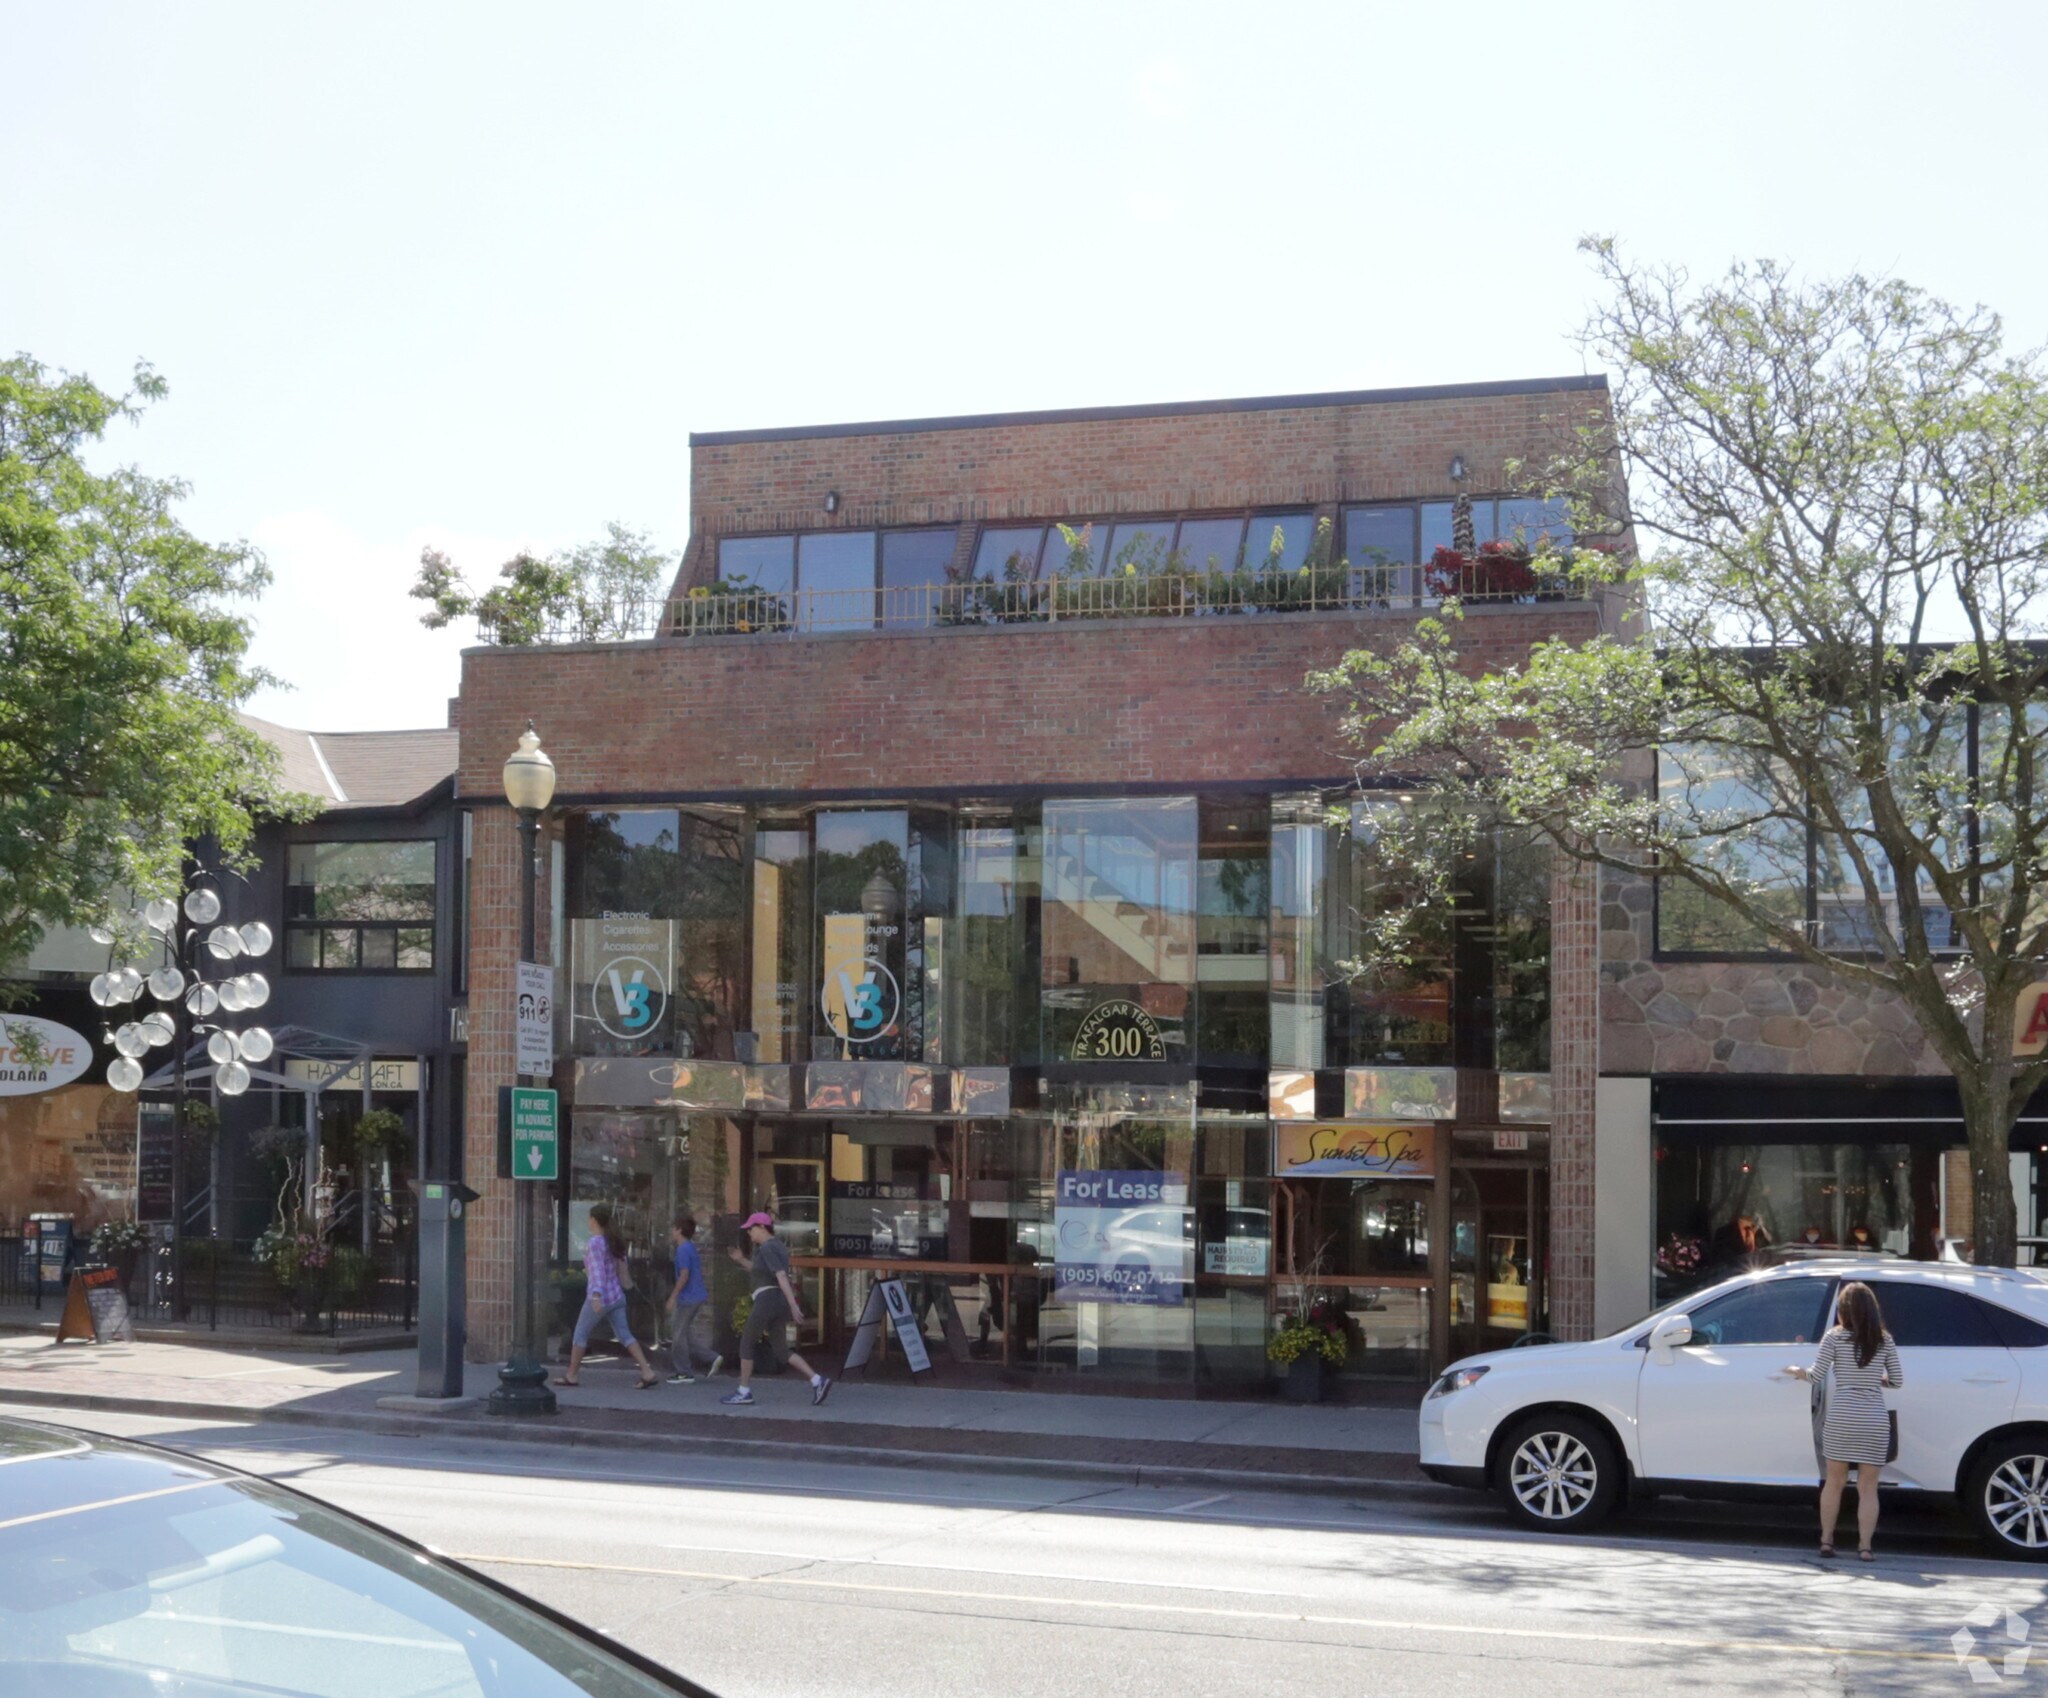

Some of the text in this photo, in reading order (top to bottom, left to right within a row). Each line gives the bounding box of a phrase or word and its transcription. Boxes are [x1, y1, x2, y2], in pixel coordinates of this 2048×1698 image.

[602, 910, 650, 920] Electronic
[602, 925, 650, 936] Cigarettes
[861, 925, 899, 938] ounge
[603, 941, 659, 952] Accessories
[519, 1006, 536, 1020] 911
[1077, 1004, 1162, 1058] TRAFALGAR TERRACE
[1095, 1027, 1141, 1057] 300
[307, 1063, 404, 1081] HACAFT
[358, 1081, 403, 1089] SON.CA
[520, 1098, 550, 1111] PAY HERE
[517, 1113, 553, 1126] IN ADVANCE
[515, 1129, 555, 1142] FOR PARKING
[1498, 1132, 1521, 1147] EXIT
[1288, 1128, 1425, 1173] Sunset Spa
[848, 1183, 917, 1198] For Lase
[1063, 1177, 1174, 1199] For Lease
[834, 1238, 866, 1252] (905)
[1062, 1268, 1176, 1284] (905) 607-0719
